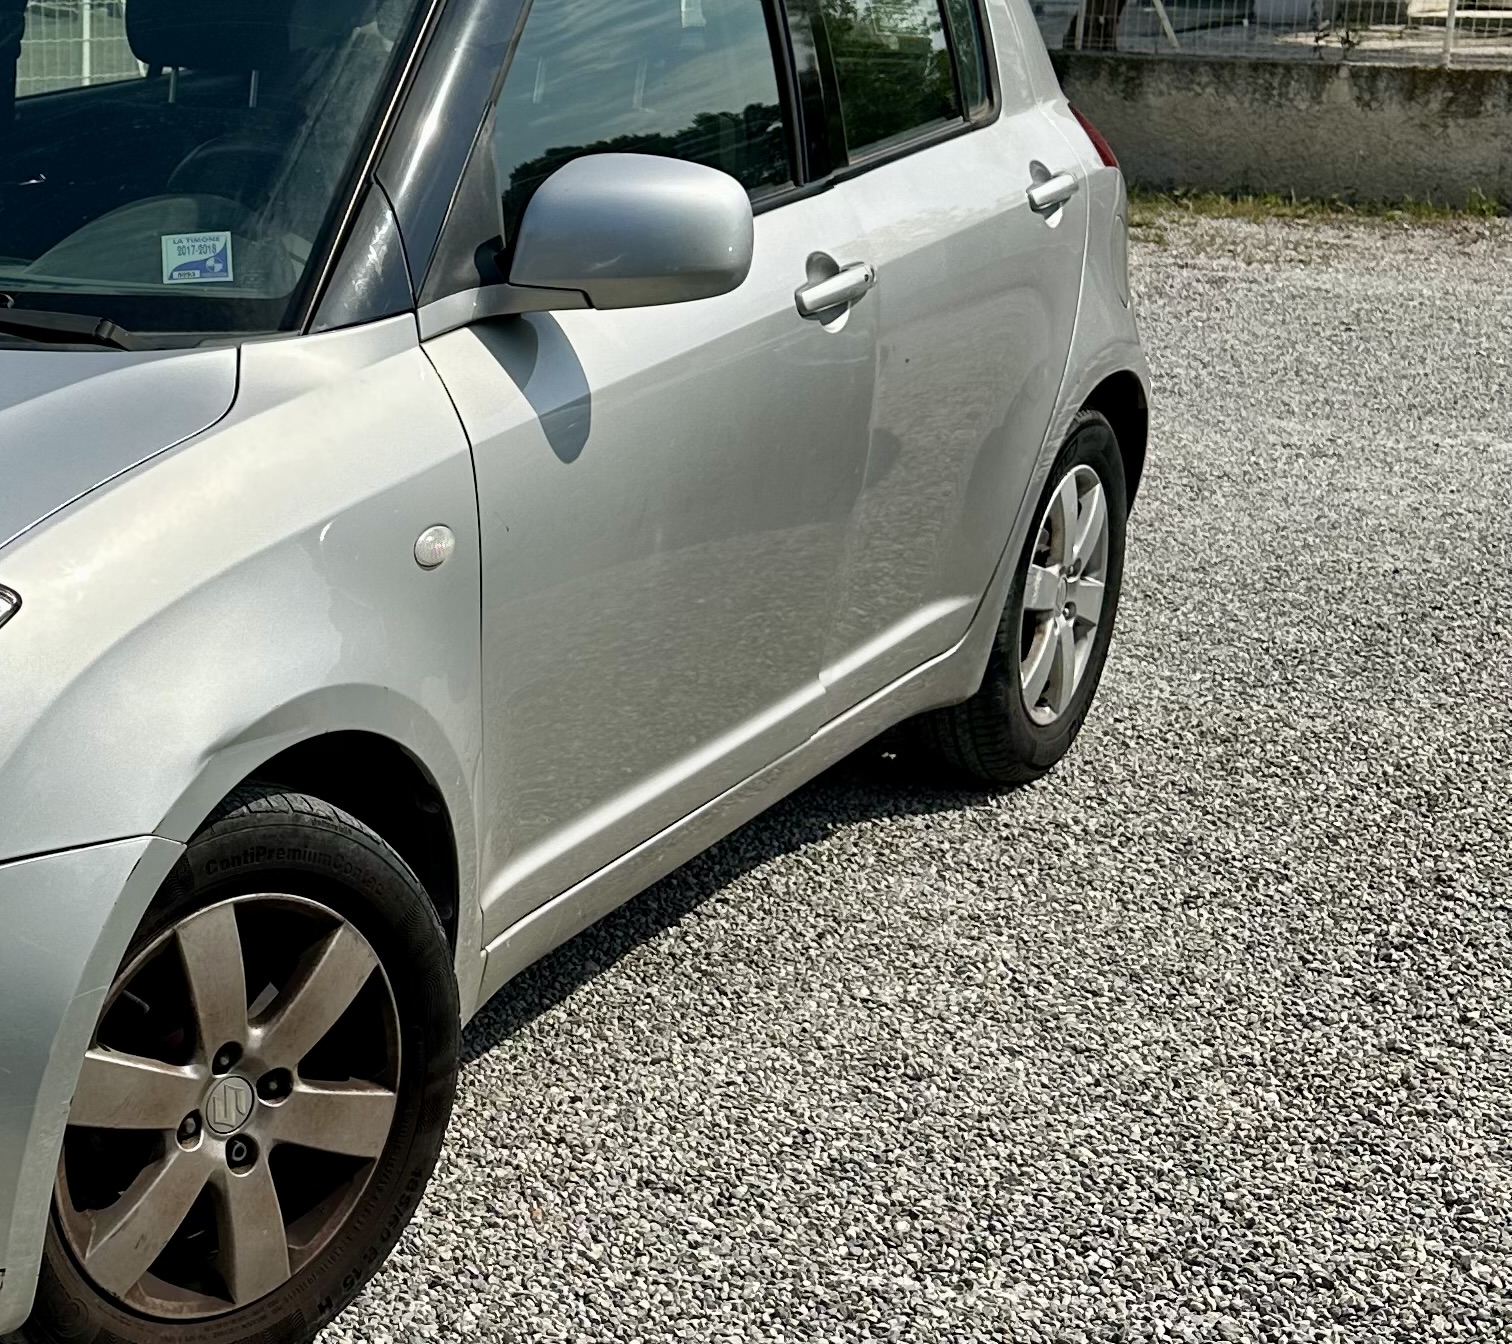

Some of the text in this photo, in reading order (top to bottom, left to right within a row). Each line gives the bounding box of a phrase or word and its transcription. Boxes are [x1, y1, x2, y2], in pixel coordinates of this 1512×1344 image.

[177, 243, 217, 256] 2017-2018
[205, 844, 393, 898] ContiPremiumContac
[316, 1294, 335, 1316] H
